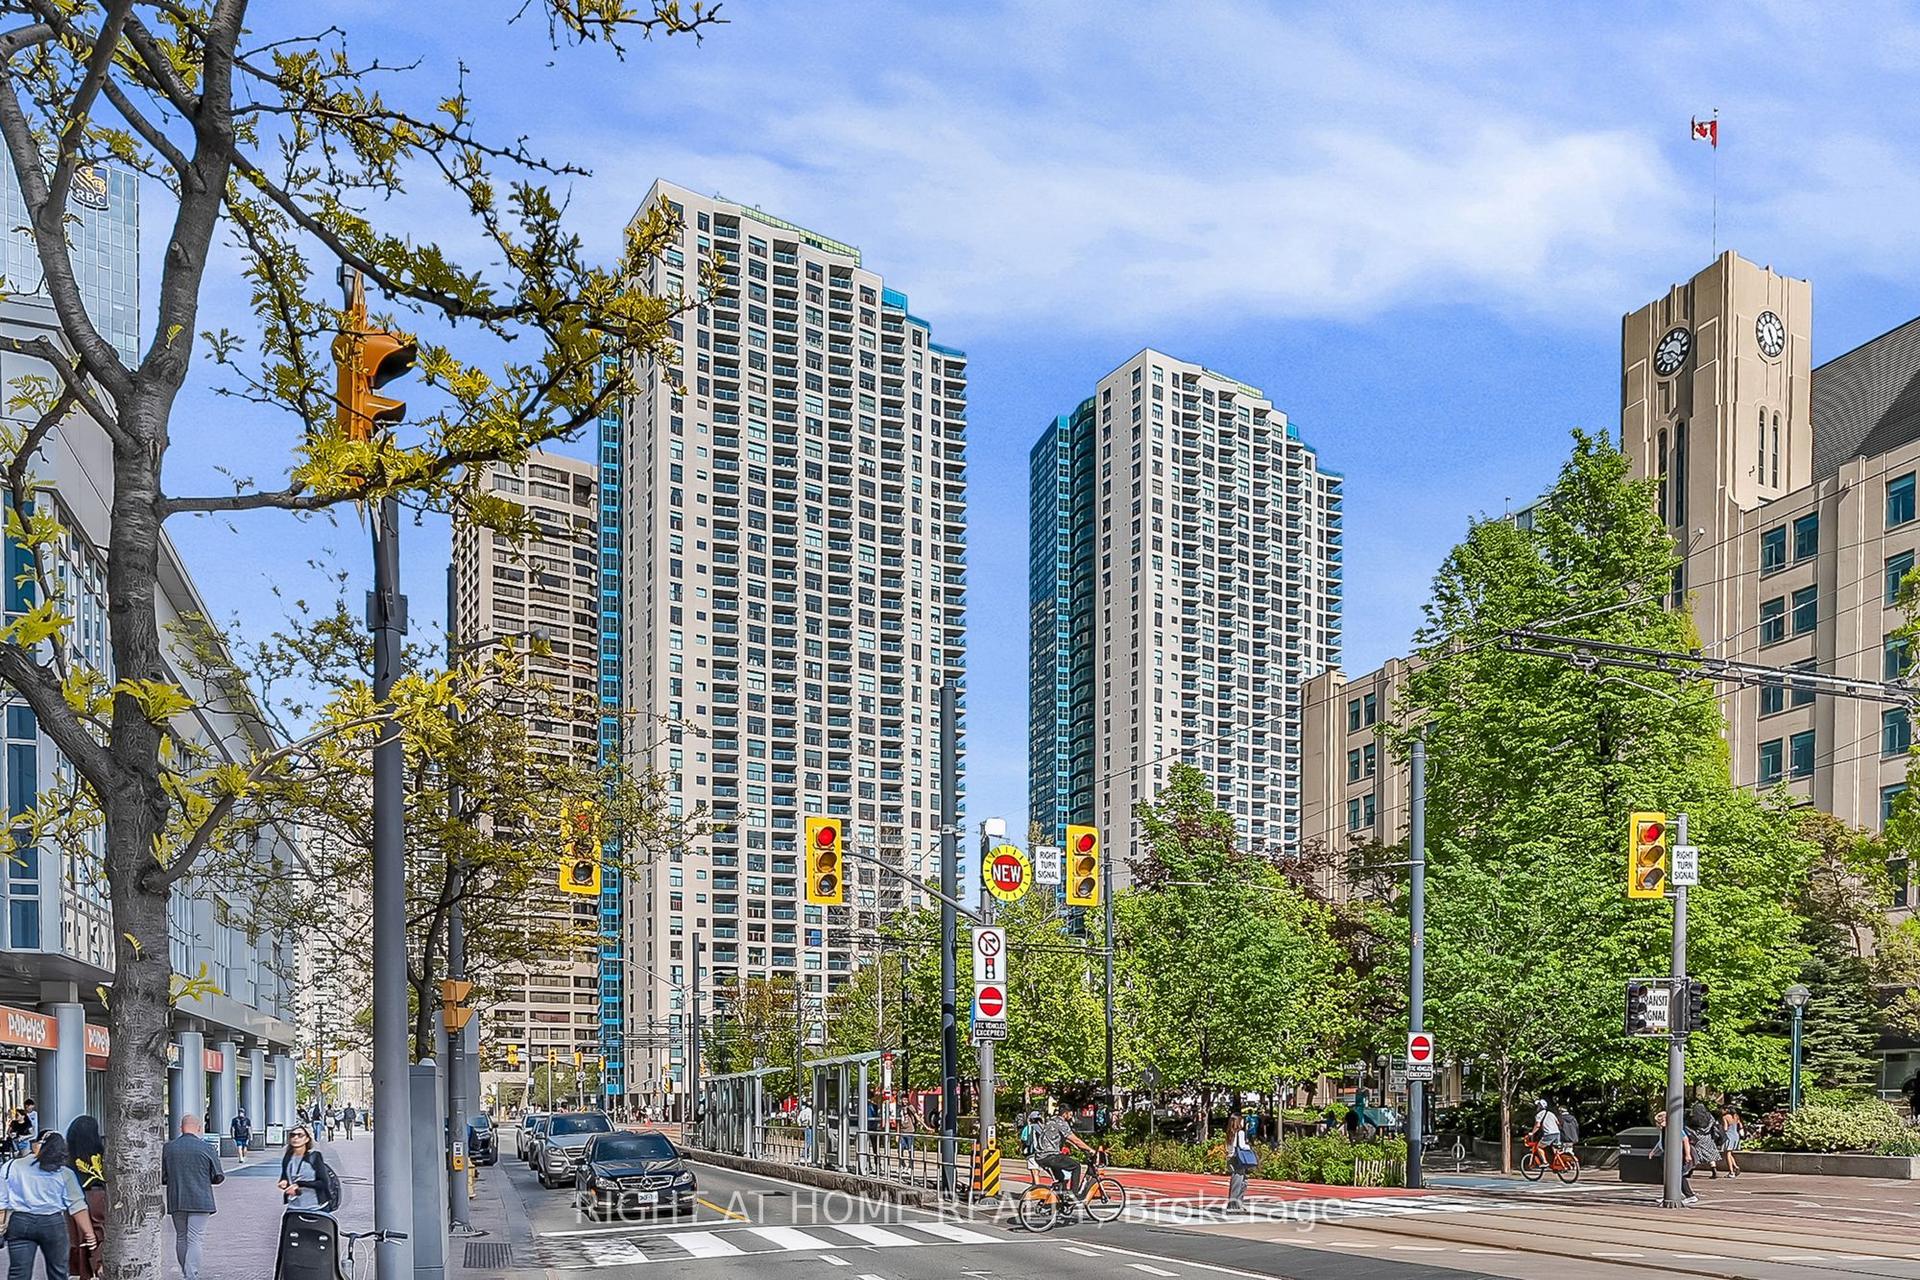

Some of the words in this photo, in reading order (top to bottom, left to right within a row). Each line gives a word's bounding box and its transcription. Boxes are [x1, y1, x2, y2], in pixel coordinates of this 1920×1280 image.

[76, 189, 105, 205] RBC
[1040, 851, 1057, 860] RIGHT
[1676, 851, 1693, 859] RIGHT
[1041, 861, 1057, 869] TURN
[1677, 861, 1693, 869] TURN
[992, 864, 1021, 883] NEW
[1037, 871, 1058, 880] SIGNAL
[1674, 871, 1695, 880] SIGNAL
[1642, 995, 1668, 1007] RANSIT
[1643, 1010, 1666, 1021] IGNAL
